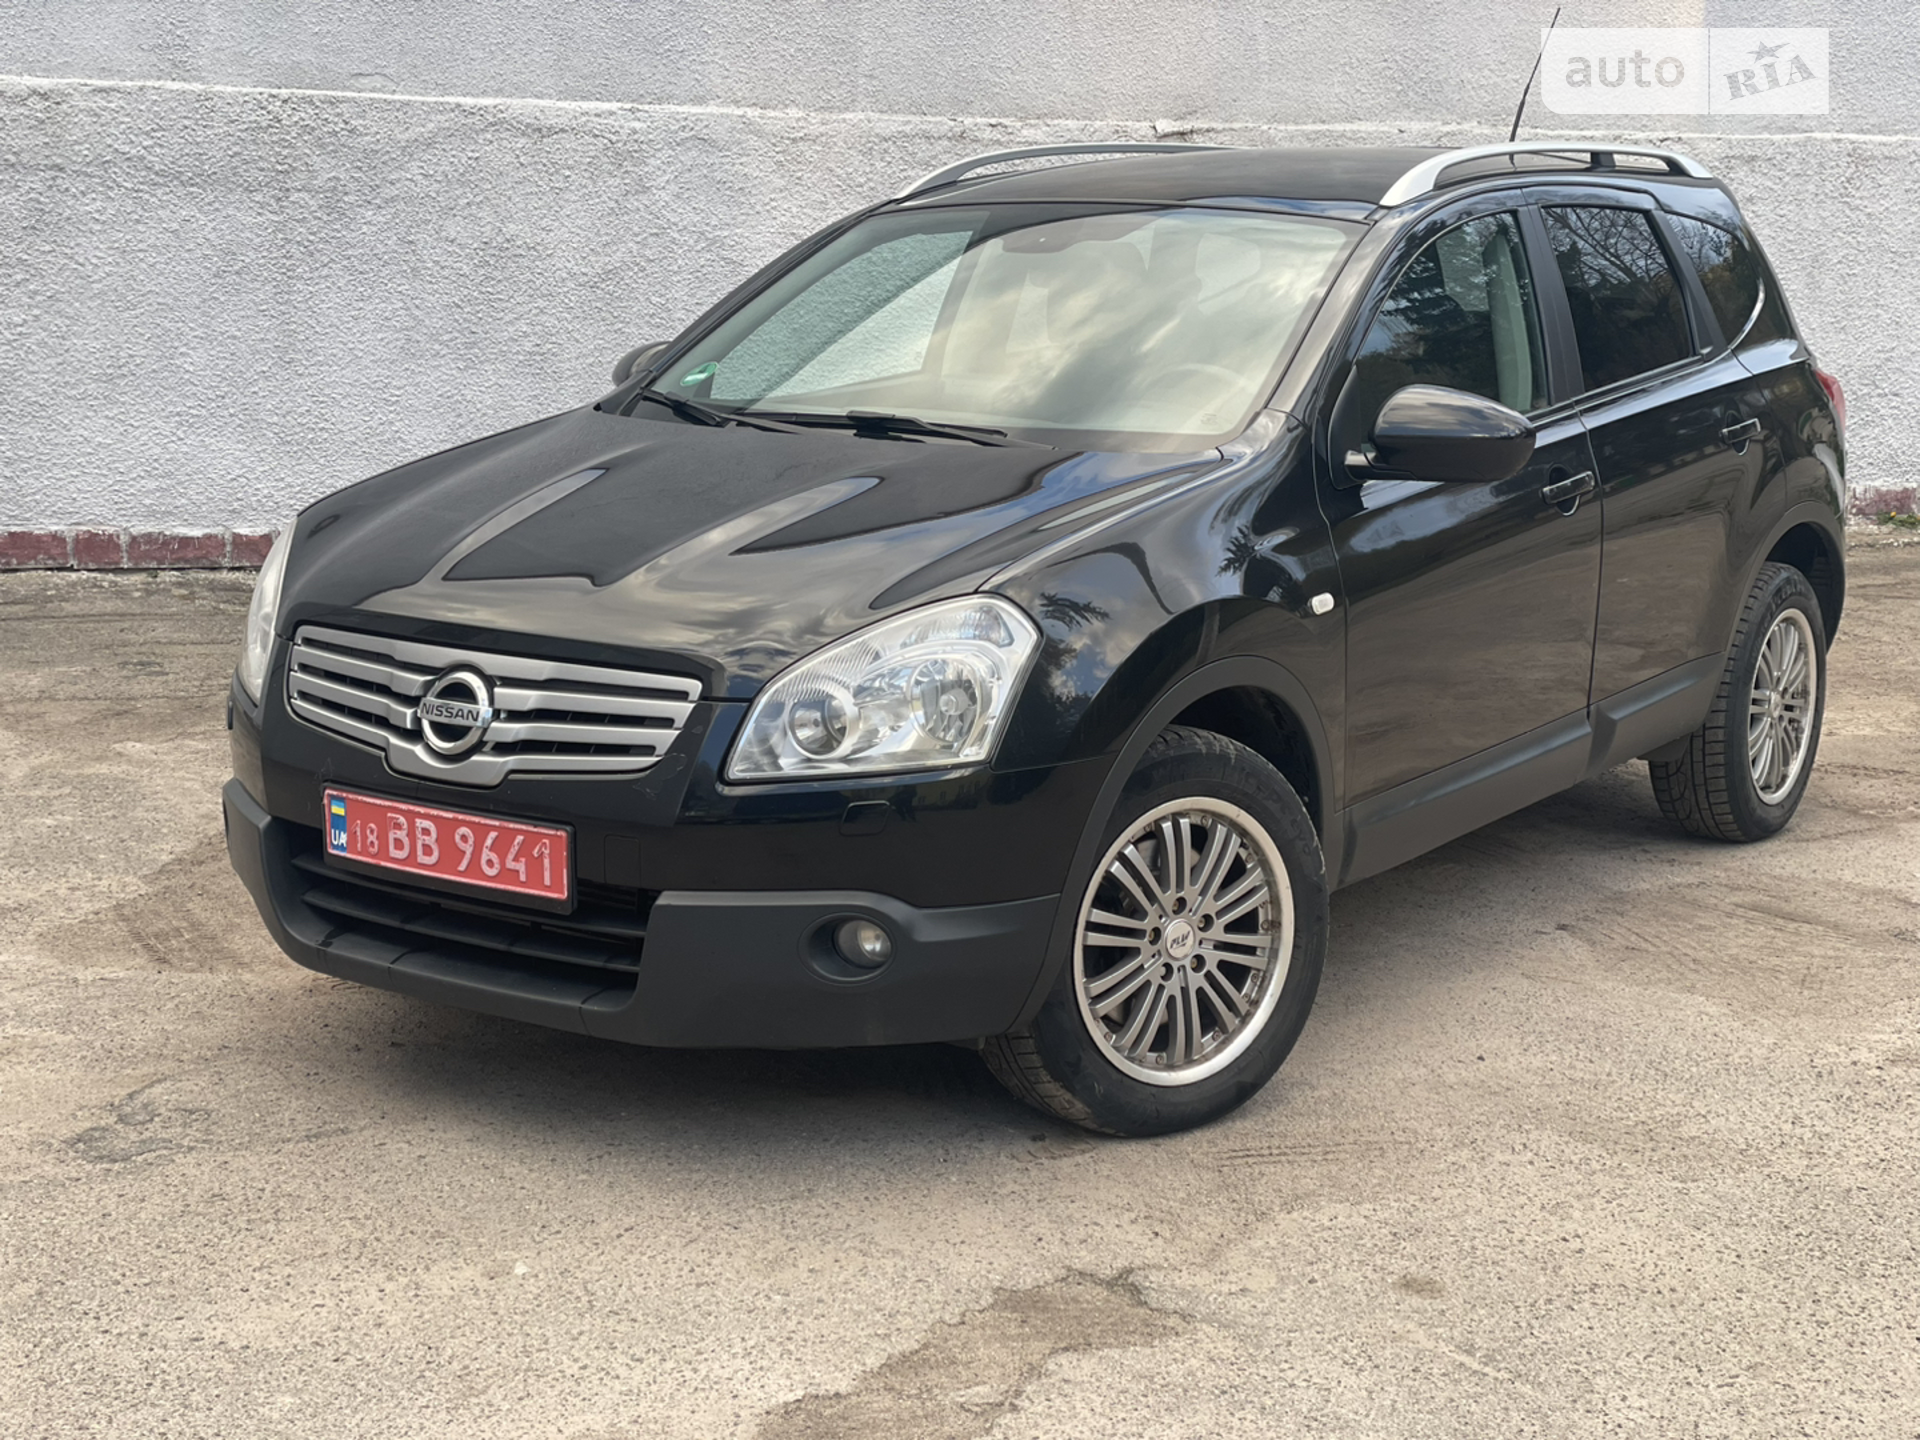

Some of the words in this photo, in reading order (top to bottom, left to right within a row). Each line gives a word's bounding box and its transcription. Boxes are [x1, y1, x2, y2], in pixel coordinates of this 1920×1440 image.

[421, 702, 480, 722] NISSAN
[331, 829, 347, 847] UA
[351, 820, 379, 855] 18
[387, 812, 440, 865] BB
[454, 826, 551, 887] 9641
